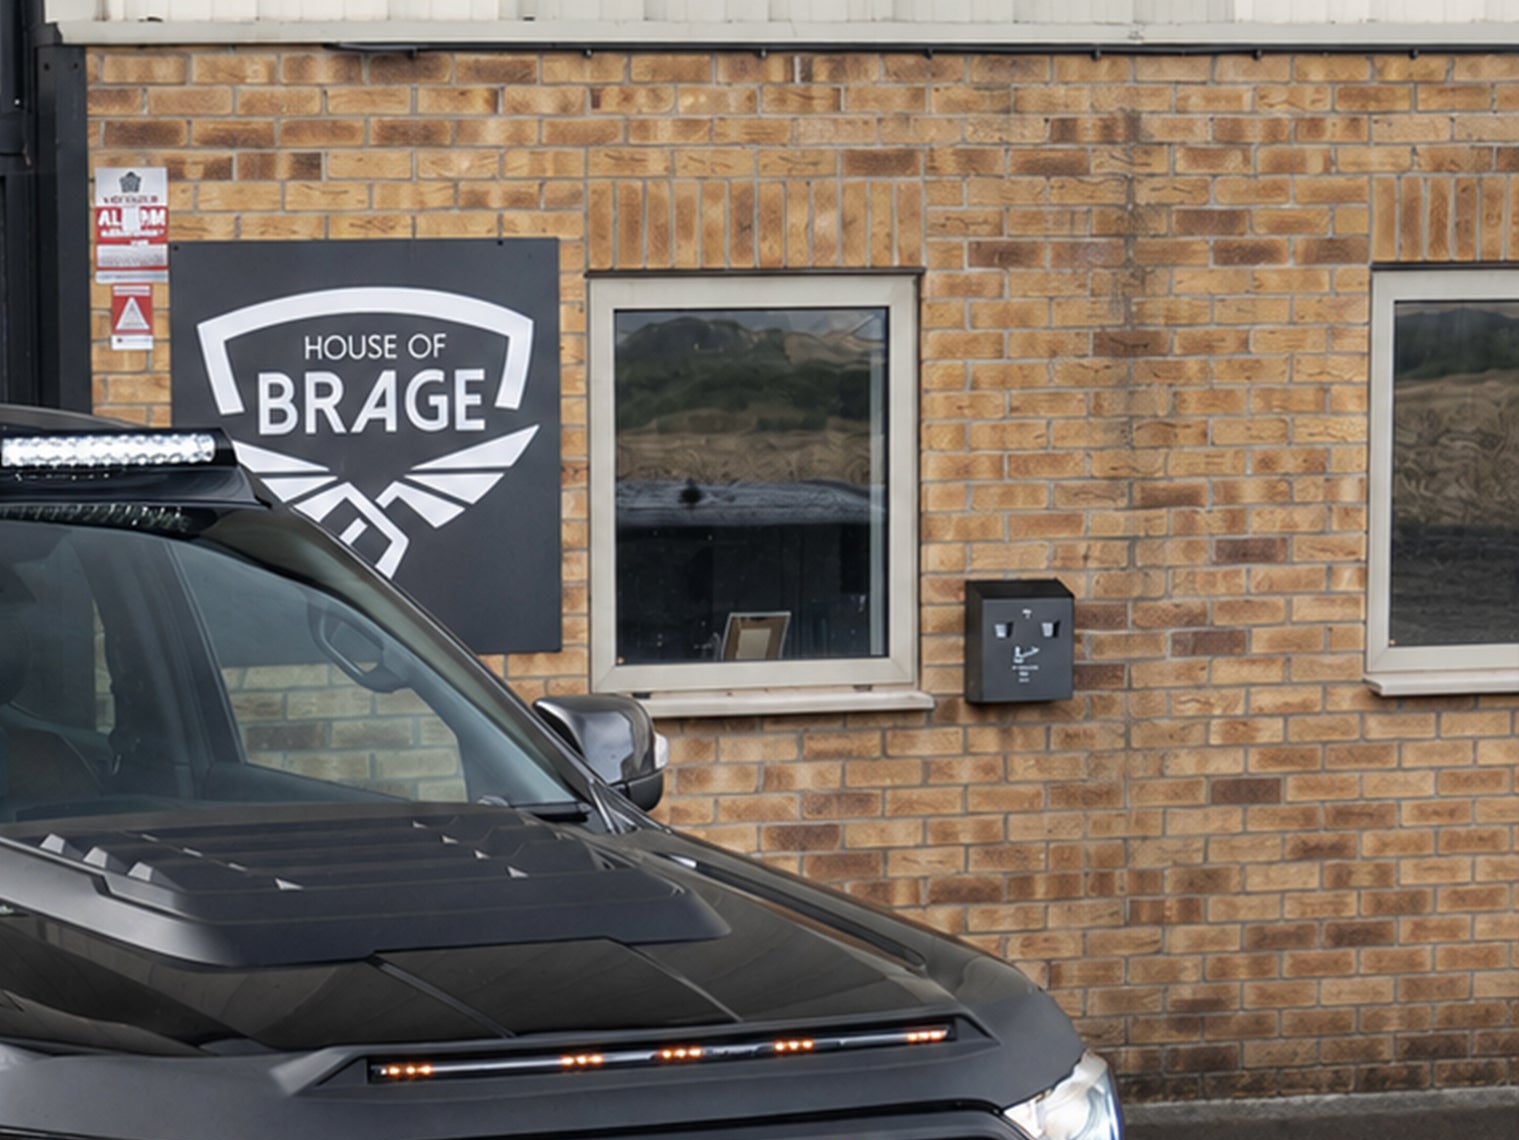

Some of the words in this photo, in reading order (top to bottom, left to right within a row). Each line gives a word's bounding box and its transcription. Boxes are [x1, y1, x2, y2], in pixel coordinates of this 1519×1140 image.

[98, 209, 166, 227] ALRM
[304, 334, 397, 360] HOUSE
[407, 333, 447, 359] OF
[258, 368, 485, 435] BRAGE
